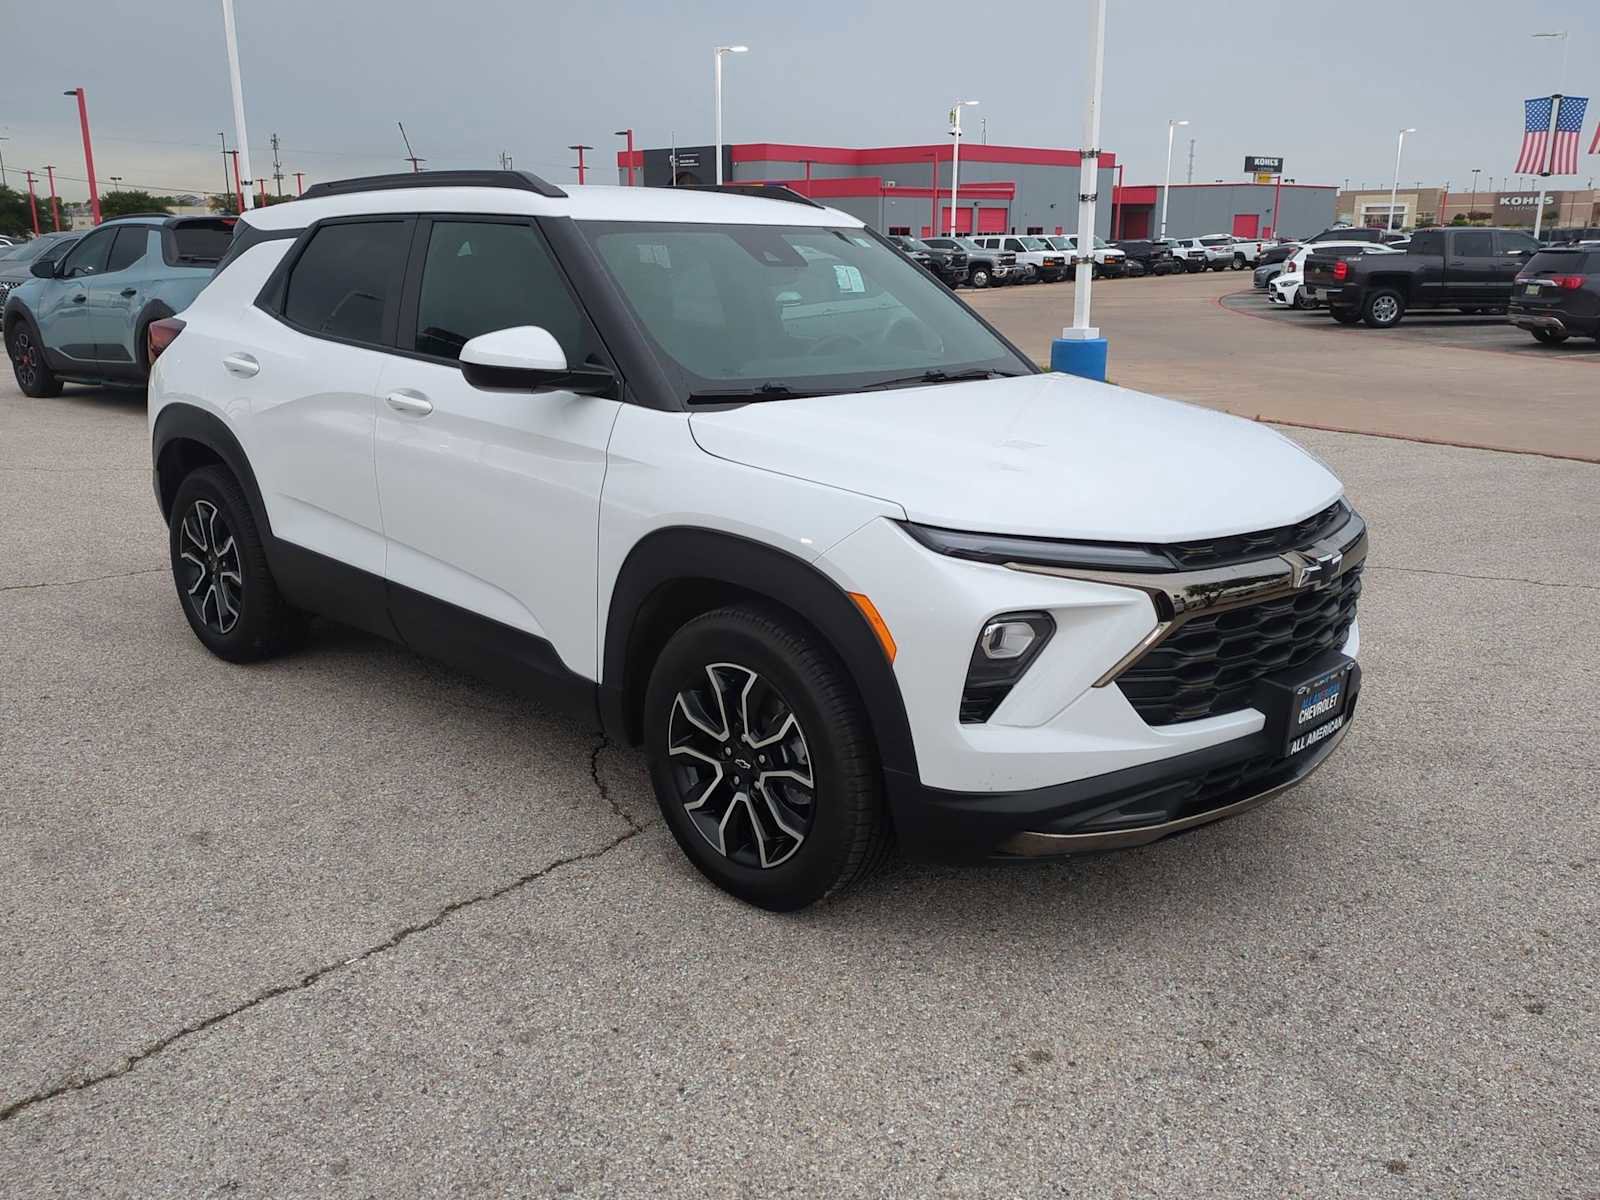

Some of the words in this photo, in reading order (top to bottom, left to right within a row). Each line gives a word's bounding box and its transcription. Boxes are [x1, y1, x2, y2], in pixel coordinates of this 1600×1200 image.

[1298, 692, 1339, 724] CHEVROLET
[1291, 737, 1306, 755] ALL
[1306, 714, 1345, 747] AMERICAN
